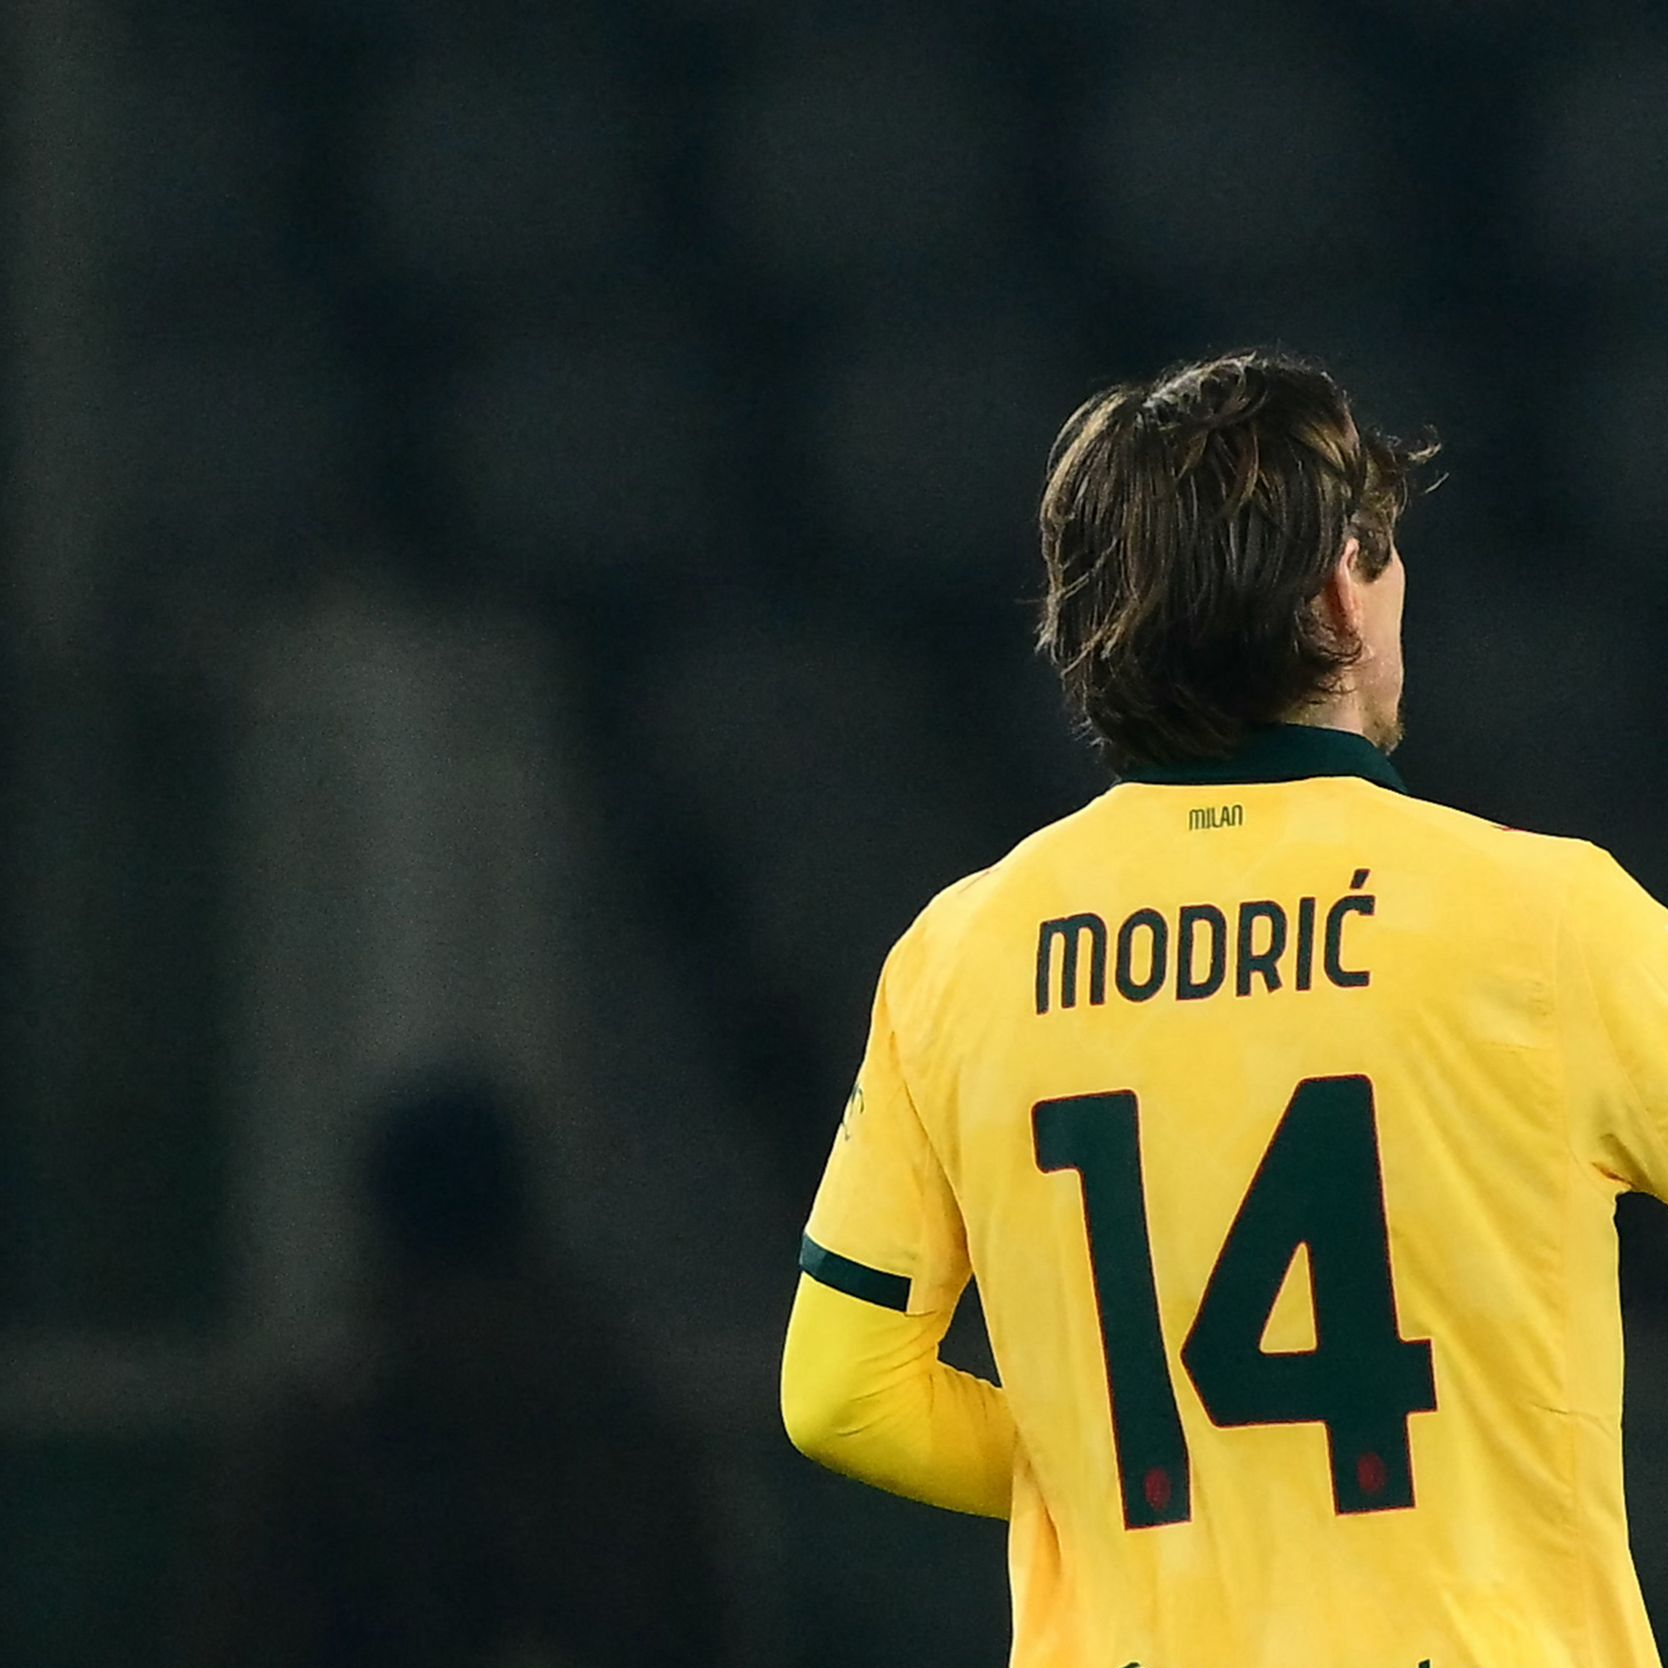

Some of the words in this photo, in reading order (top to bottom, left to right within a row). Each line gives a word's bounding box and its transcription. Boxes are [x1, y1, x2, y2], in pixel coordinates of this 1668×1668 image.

[1188, 804, 1243, 831] MILAN
[1036, 868, 1376, 1015] MODRIĆ
[1031, 1073, 1438, 1531] 14
